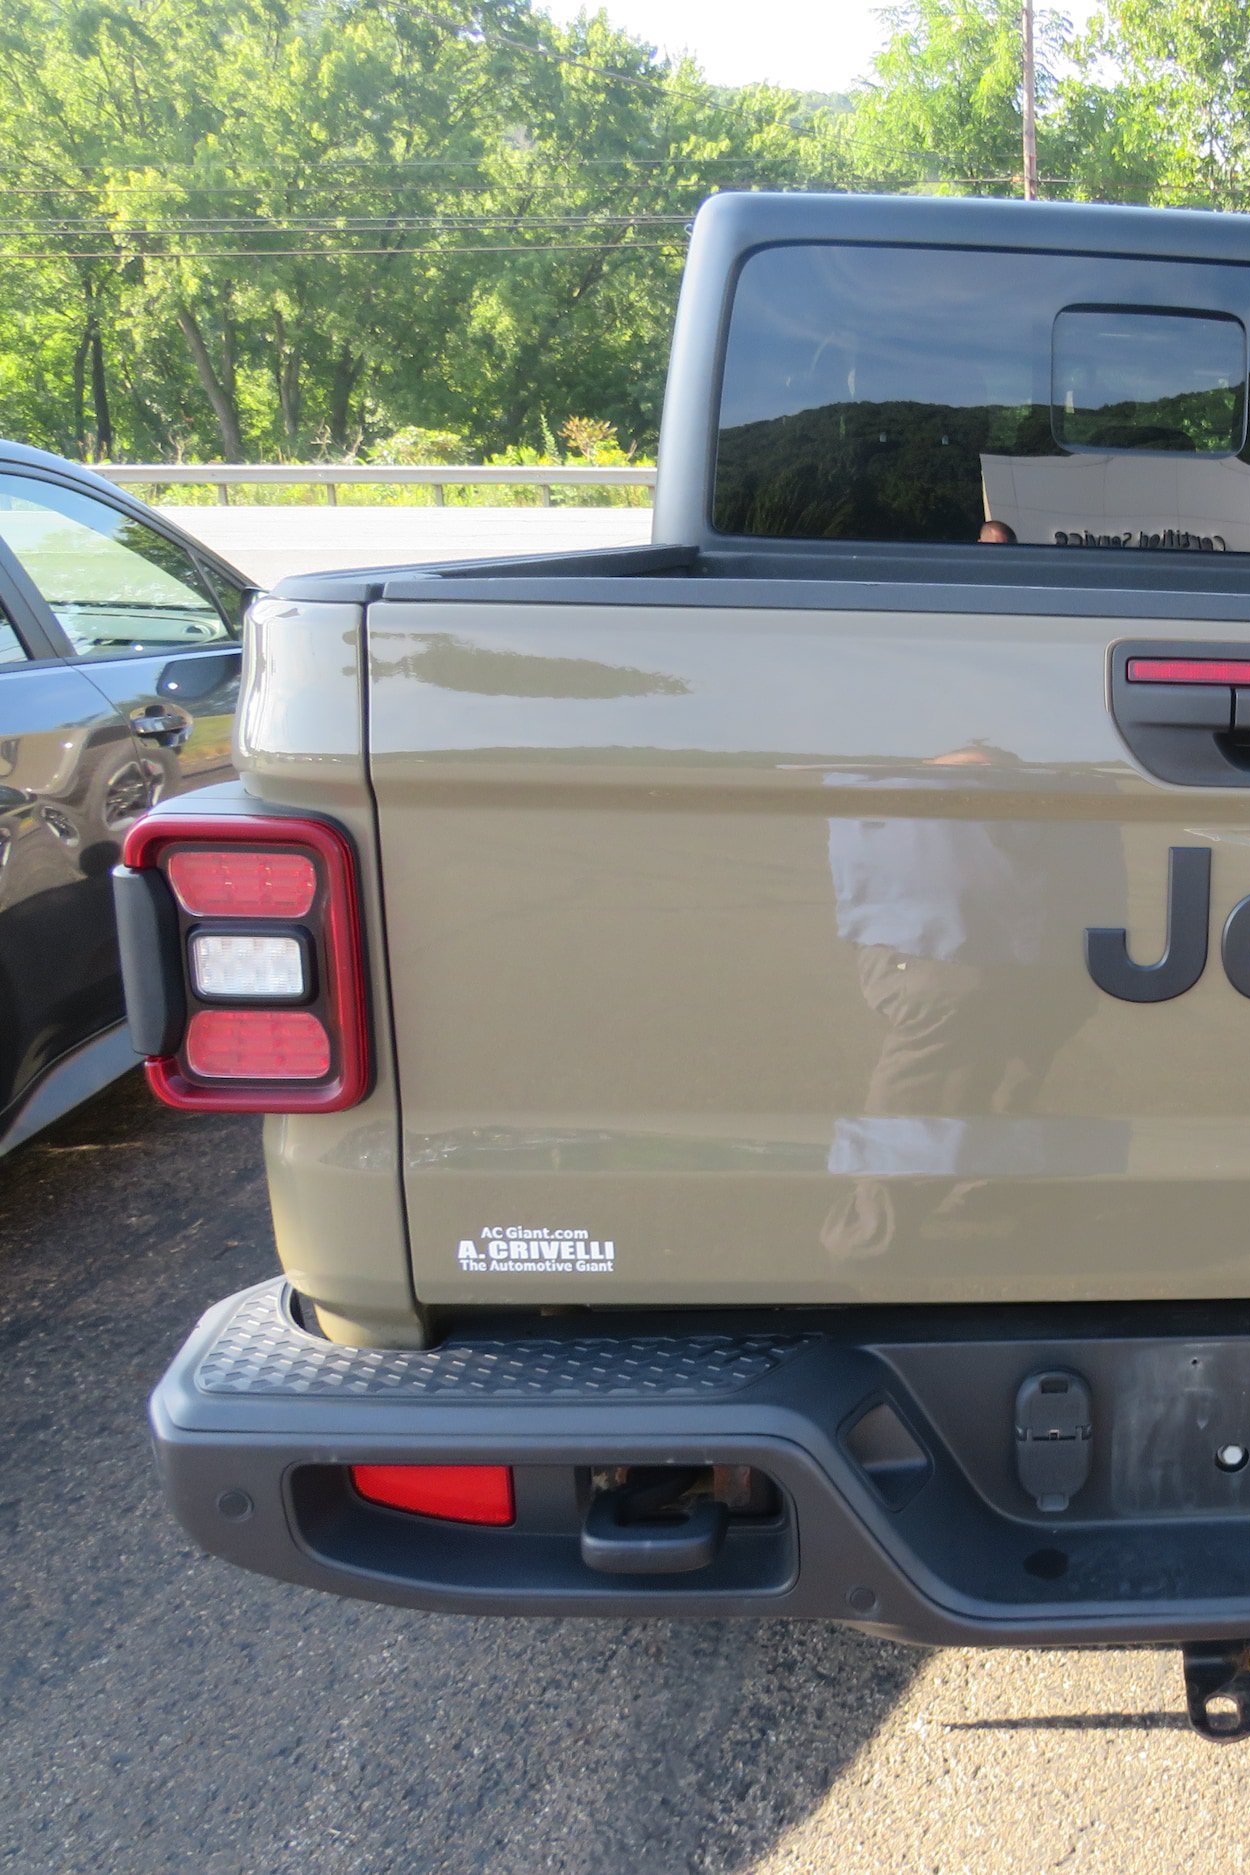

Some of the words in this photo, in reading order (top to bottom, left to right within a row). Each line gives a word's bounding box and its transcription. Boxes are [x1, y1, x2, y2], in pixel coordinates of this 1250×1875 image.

[481, 1227, 503, 1239] AC
[506, 1226, 589, 1239] Giant.com
[460, 1260, 487, 1271] The
[490, 1260, 573, 1271] Automotive
[576, 1260, 614, 1272] Giant
